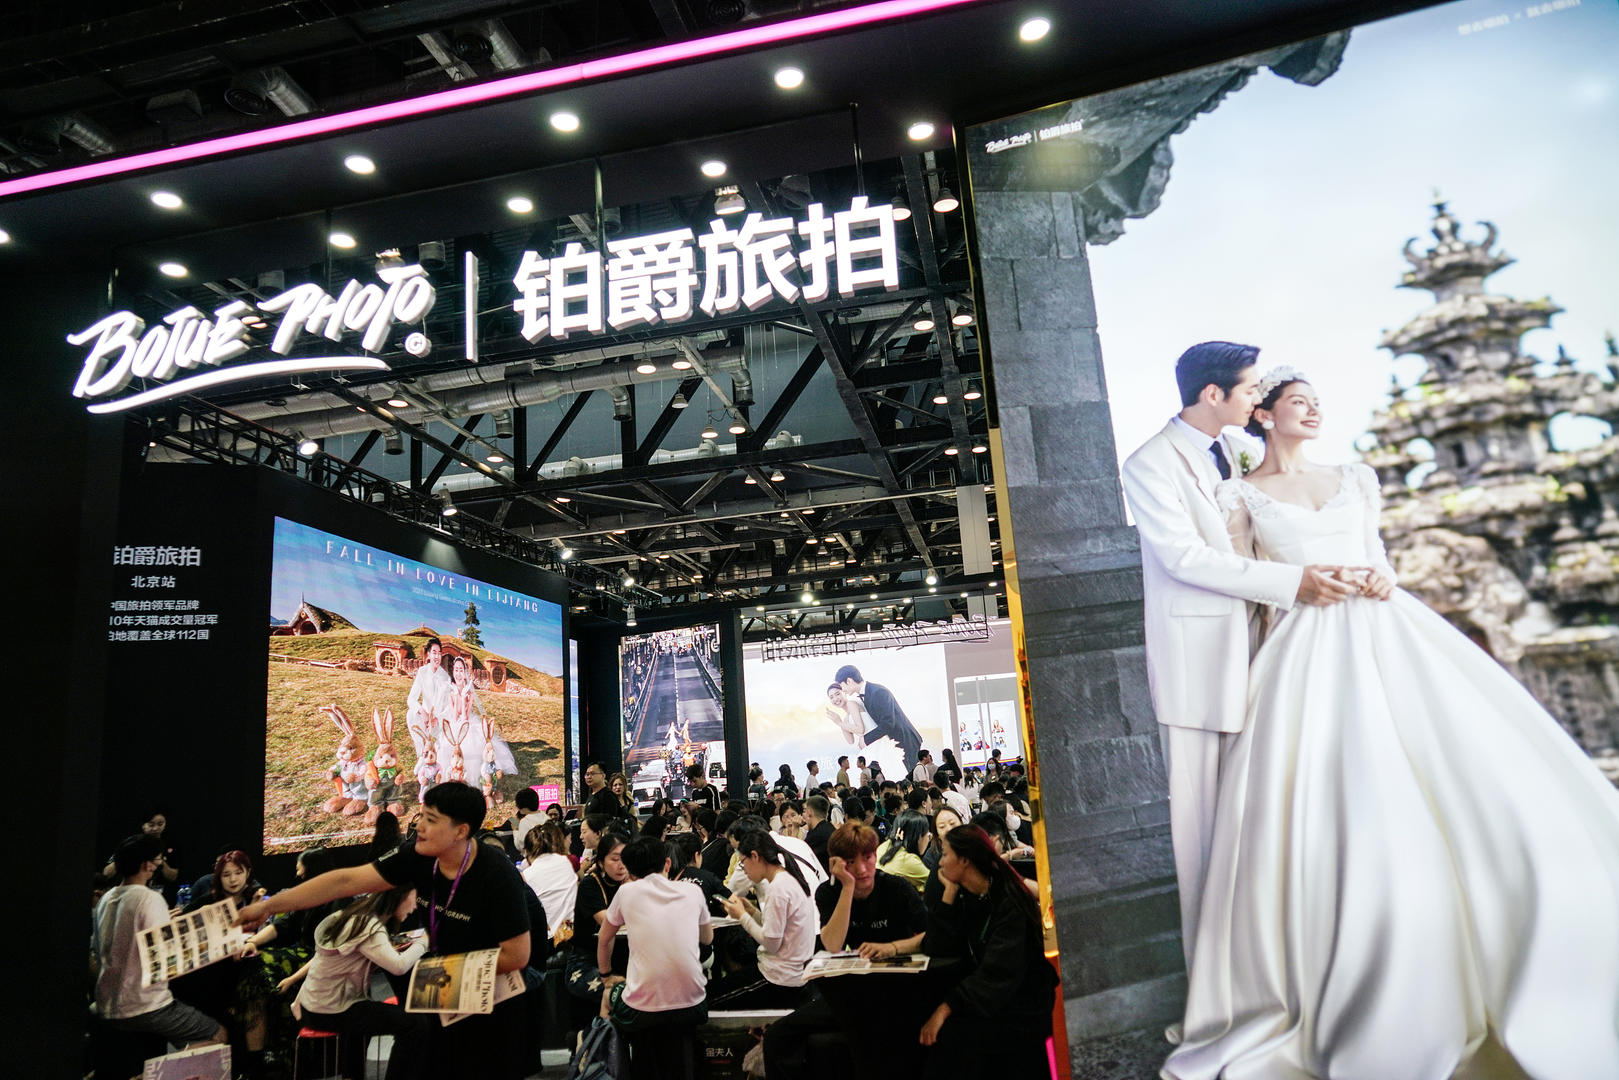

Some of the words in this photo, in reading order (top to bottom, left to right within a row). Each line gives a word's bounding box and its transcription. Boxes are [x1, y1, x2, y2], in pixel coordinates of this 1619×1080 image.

[256, 264, 436, 355] PHOTO
[513, 196, 901, 345] 铂爵旅拍
[131, 576, 176, 588] 北京站
[326, 540, 374, 566] FALL
[388, 559, 405, 575] IN
[416, 567, 456, 590] LOVE
[465, 582, 479, 597] IN
[488, 589, 539, 613] LIJIANG
